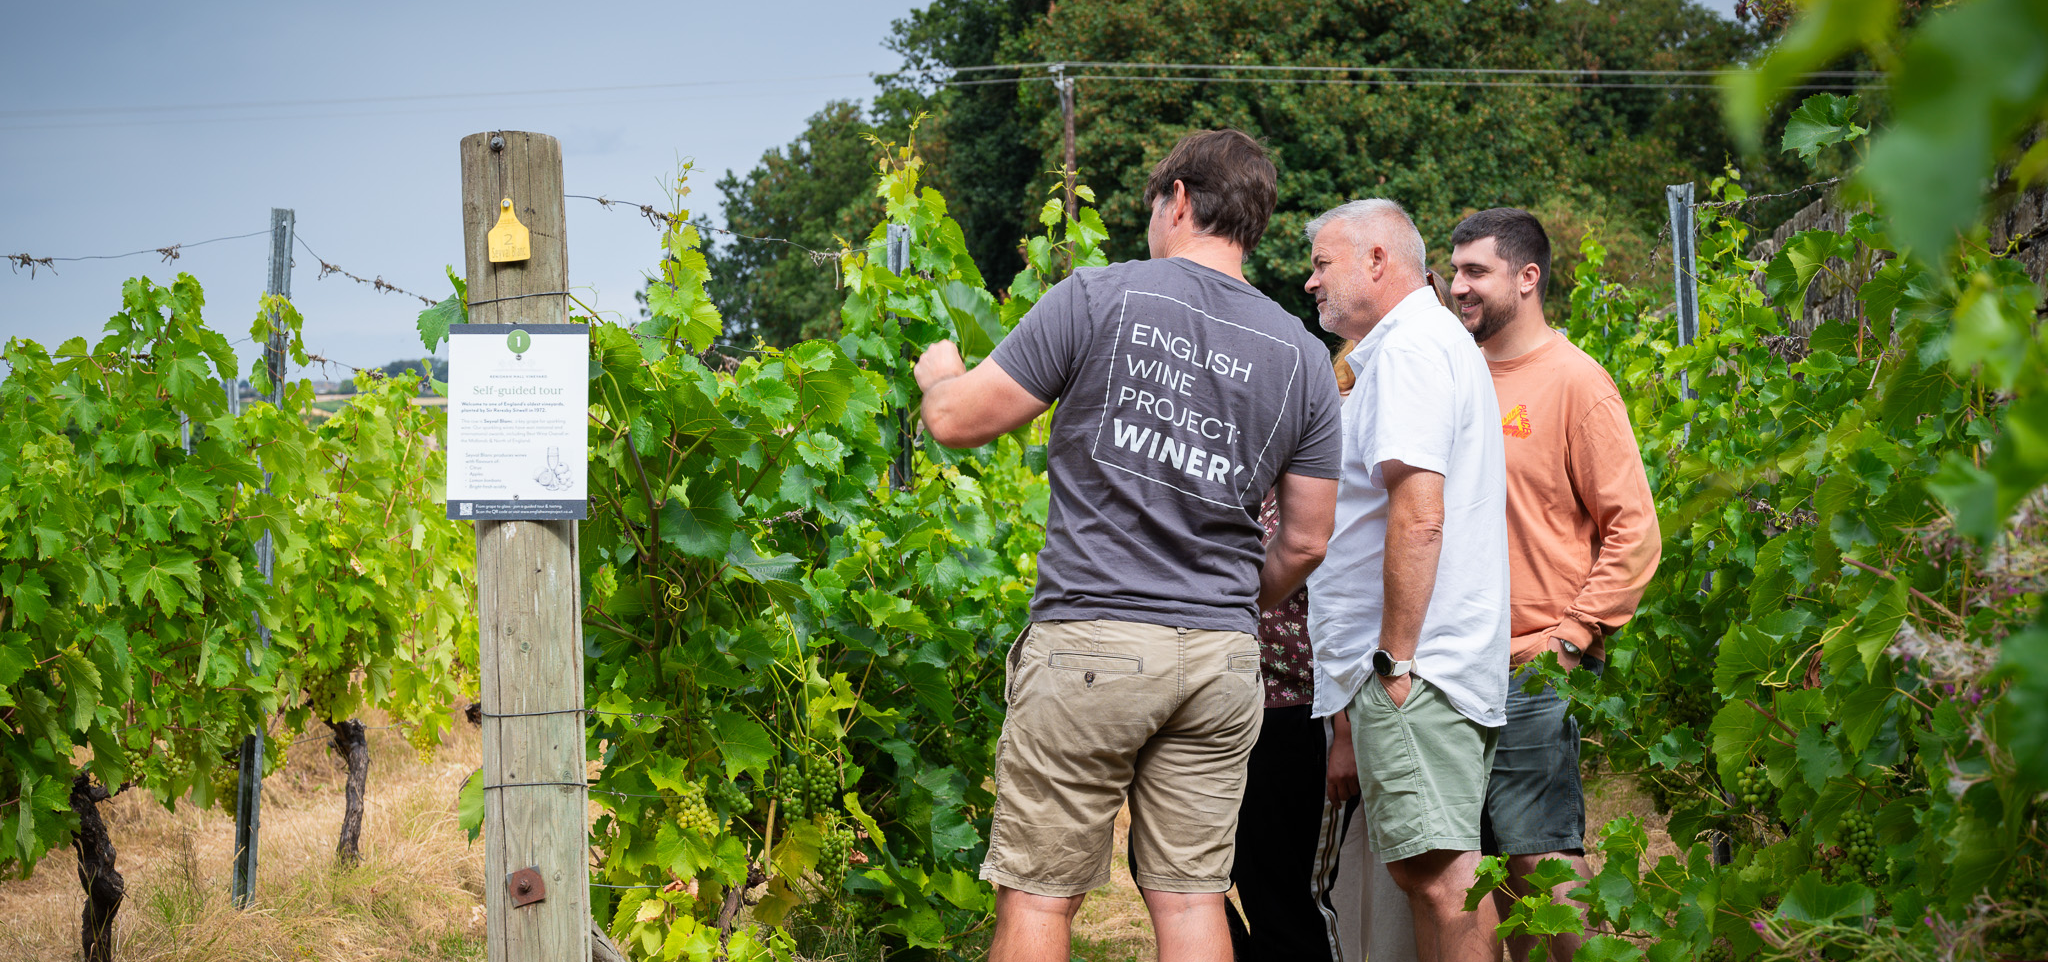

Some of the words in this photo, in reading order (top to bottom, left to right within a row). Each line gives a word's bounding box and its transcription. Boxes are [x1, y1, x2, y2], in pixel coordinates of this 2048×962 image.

[504, 234, 514, 246] 2
[516, 336, 521, 347] 1
[1130, 322, 1253, 383] ENGLISH
[1126, 354, 1196, 397] WINE
[472, 386, 536, 397] Self-guided
[539, 386, 564, 396] tour
[1117, 385, 1241, 445] PROJECT:
